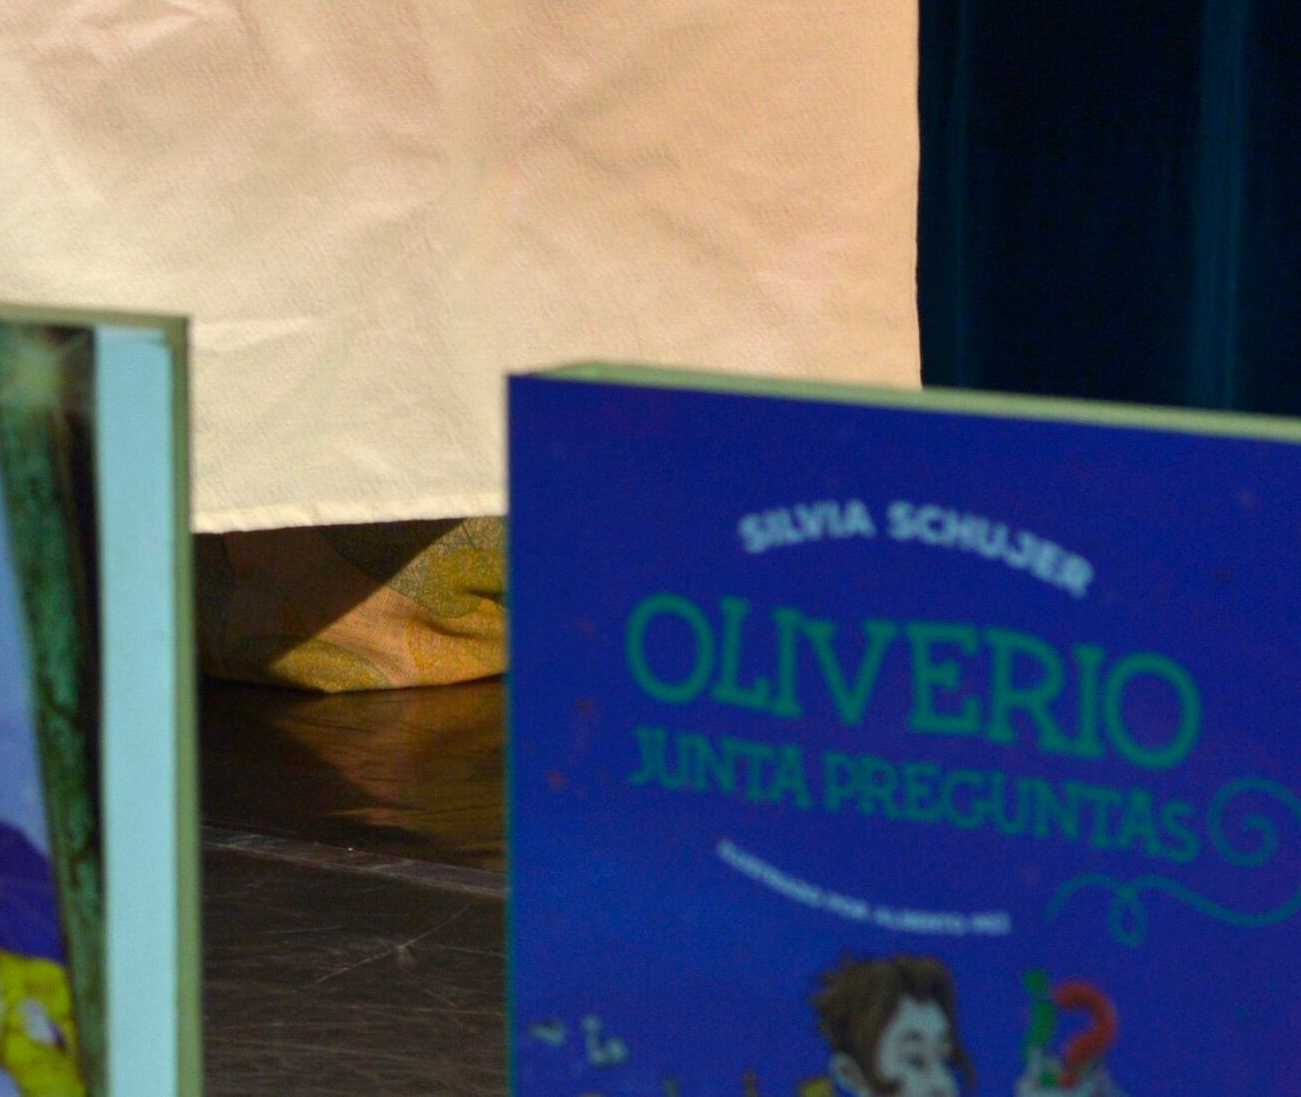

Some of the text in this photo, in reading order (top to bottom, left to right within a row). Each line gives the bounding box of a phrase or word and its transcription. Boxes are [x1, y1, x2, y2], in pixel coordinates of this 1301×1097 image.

[737, 498, 1096, 599] SILVIA SCHUJER
[624, 591, 1203, 770] OLIVERIO
[627, 724, 1201, 864] JUNTA PREGUNTAS
